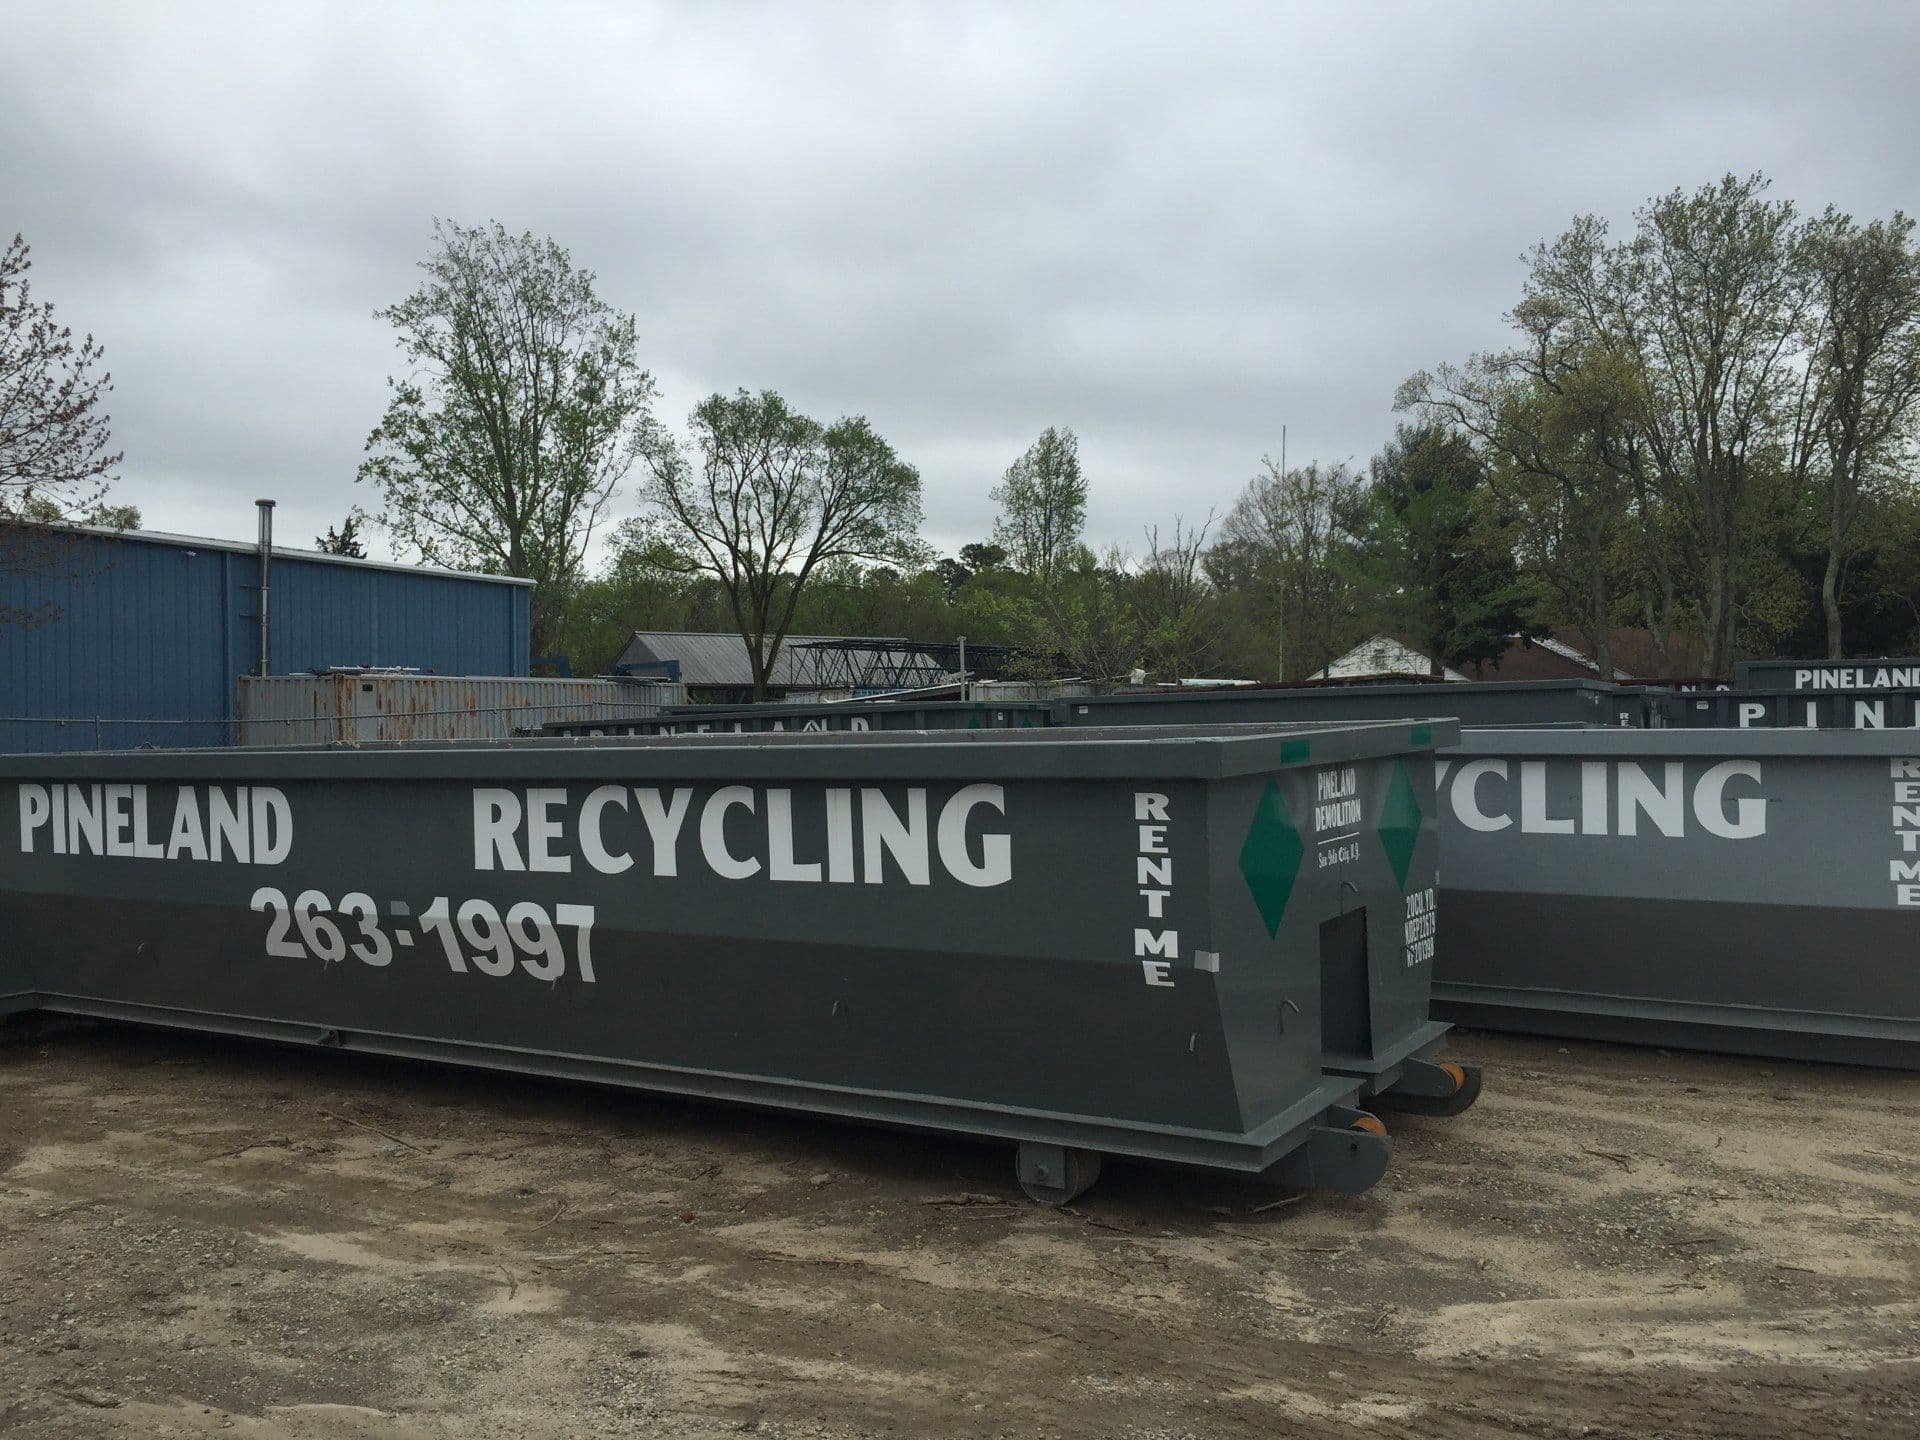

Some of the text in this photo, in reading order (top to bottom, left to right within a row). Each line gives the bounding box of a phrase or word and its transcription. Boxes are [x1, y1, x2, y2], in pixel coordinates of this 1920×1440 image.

[1739, 700, 1920, 728] PIN
[1315, 799, 1361, 832] DEMOLITION
[1317, 768, 1356, 801] PINELAND
[1436, 758, 1767, 839] CLING
[19, 785, 1012, 887] PINELAND RECYCLING
[1134, 793, 1179, 988] RENT ME
[250, 886, 596, 983] 263-1997
